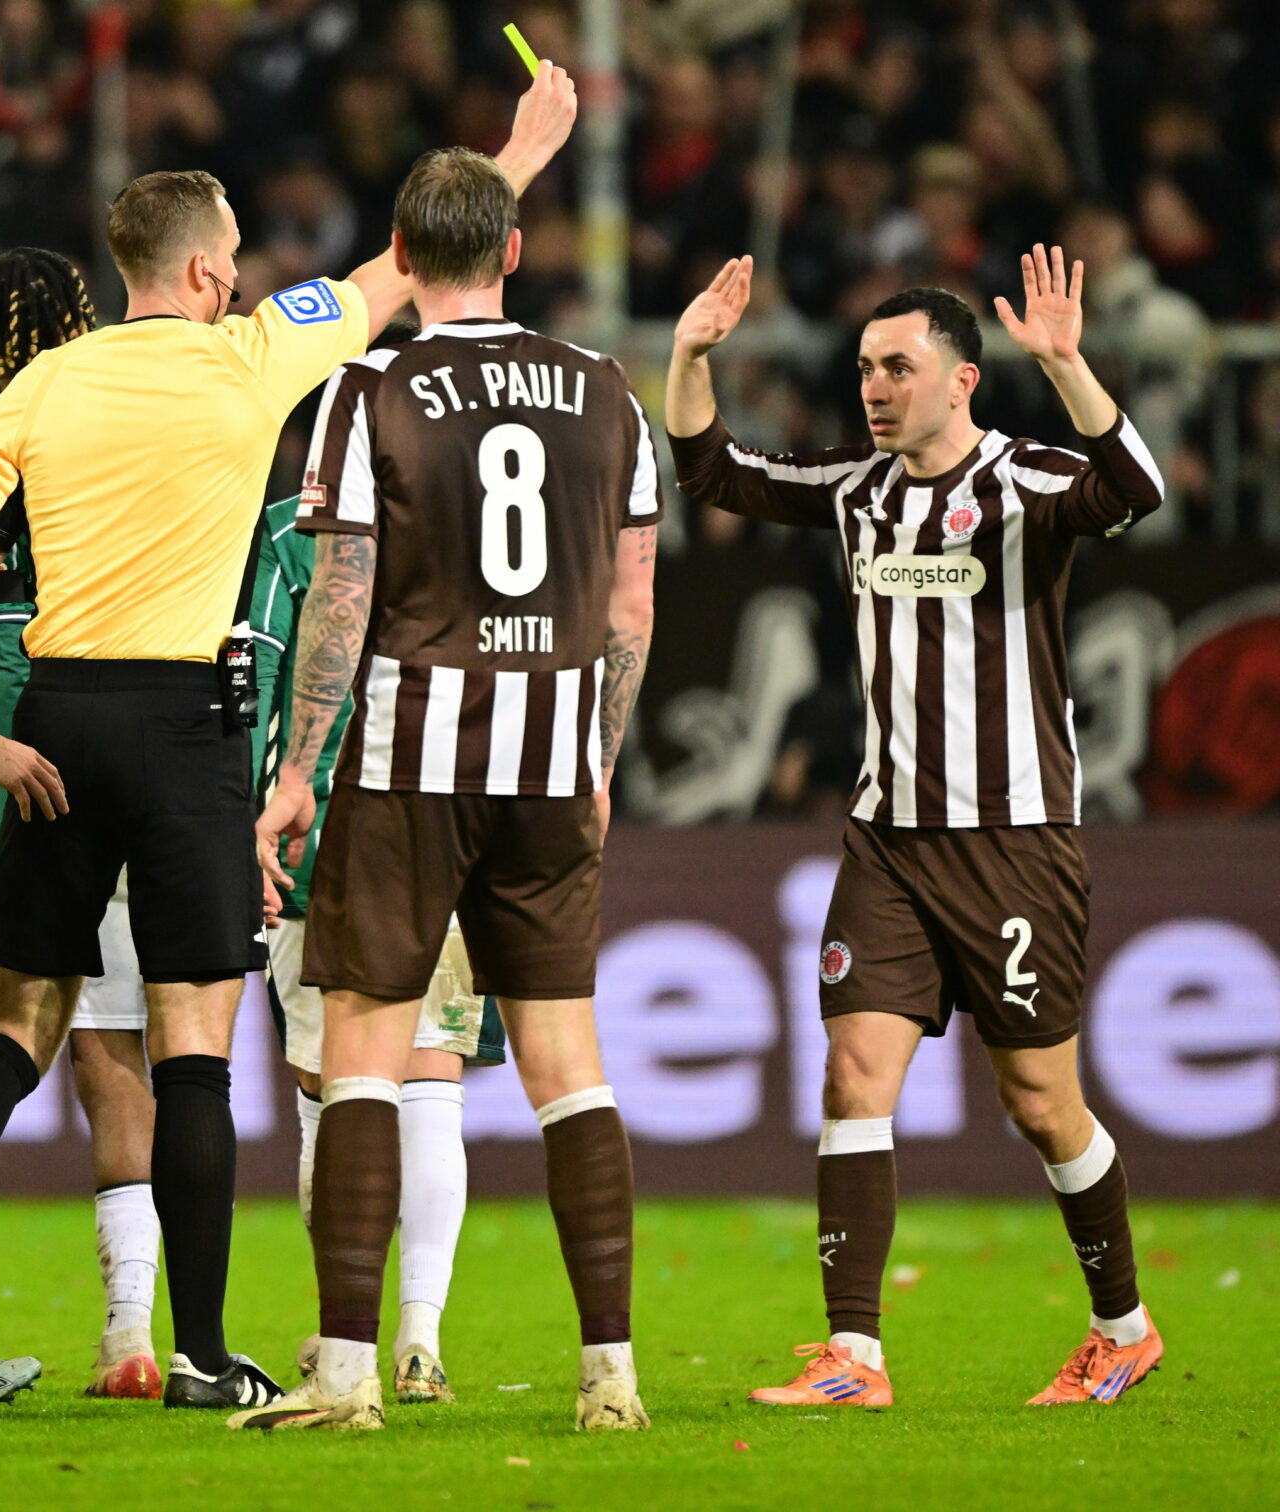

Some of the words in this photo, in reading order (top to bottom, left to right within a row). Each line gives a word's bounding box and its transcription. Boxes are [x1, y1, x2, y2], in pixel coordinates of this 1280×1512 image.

[410, 366, 477, 419] ST.
[480, 361, 586, 417] PAULI
[478, 422, 548, 597] 8
[880, 563, 973, 590] congstar
[478, 616, 553, 653] SMITH
[1001, 917, 1037, 987] 2
